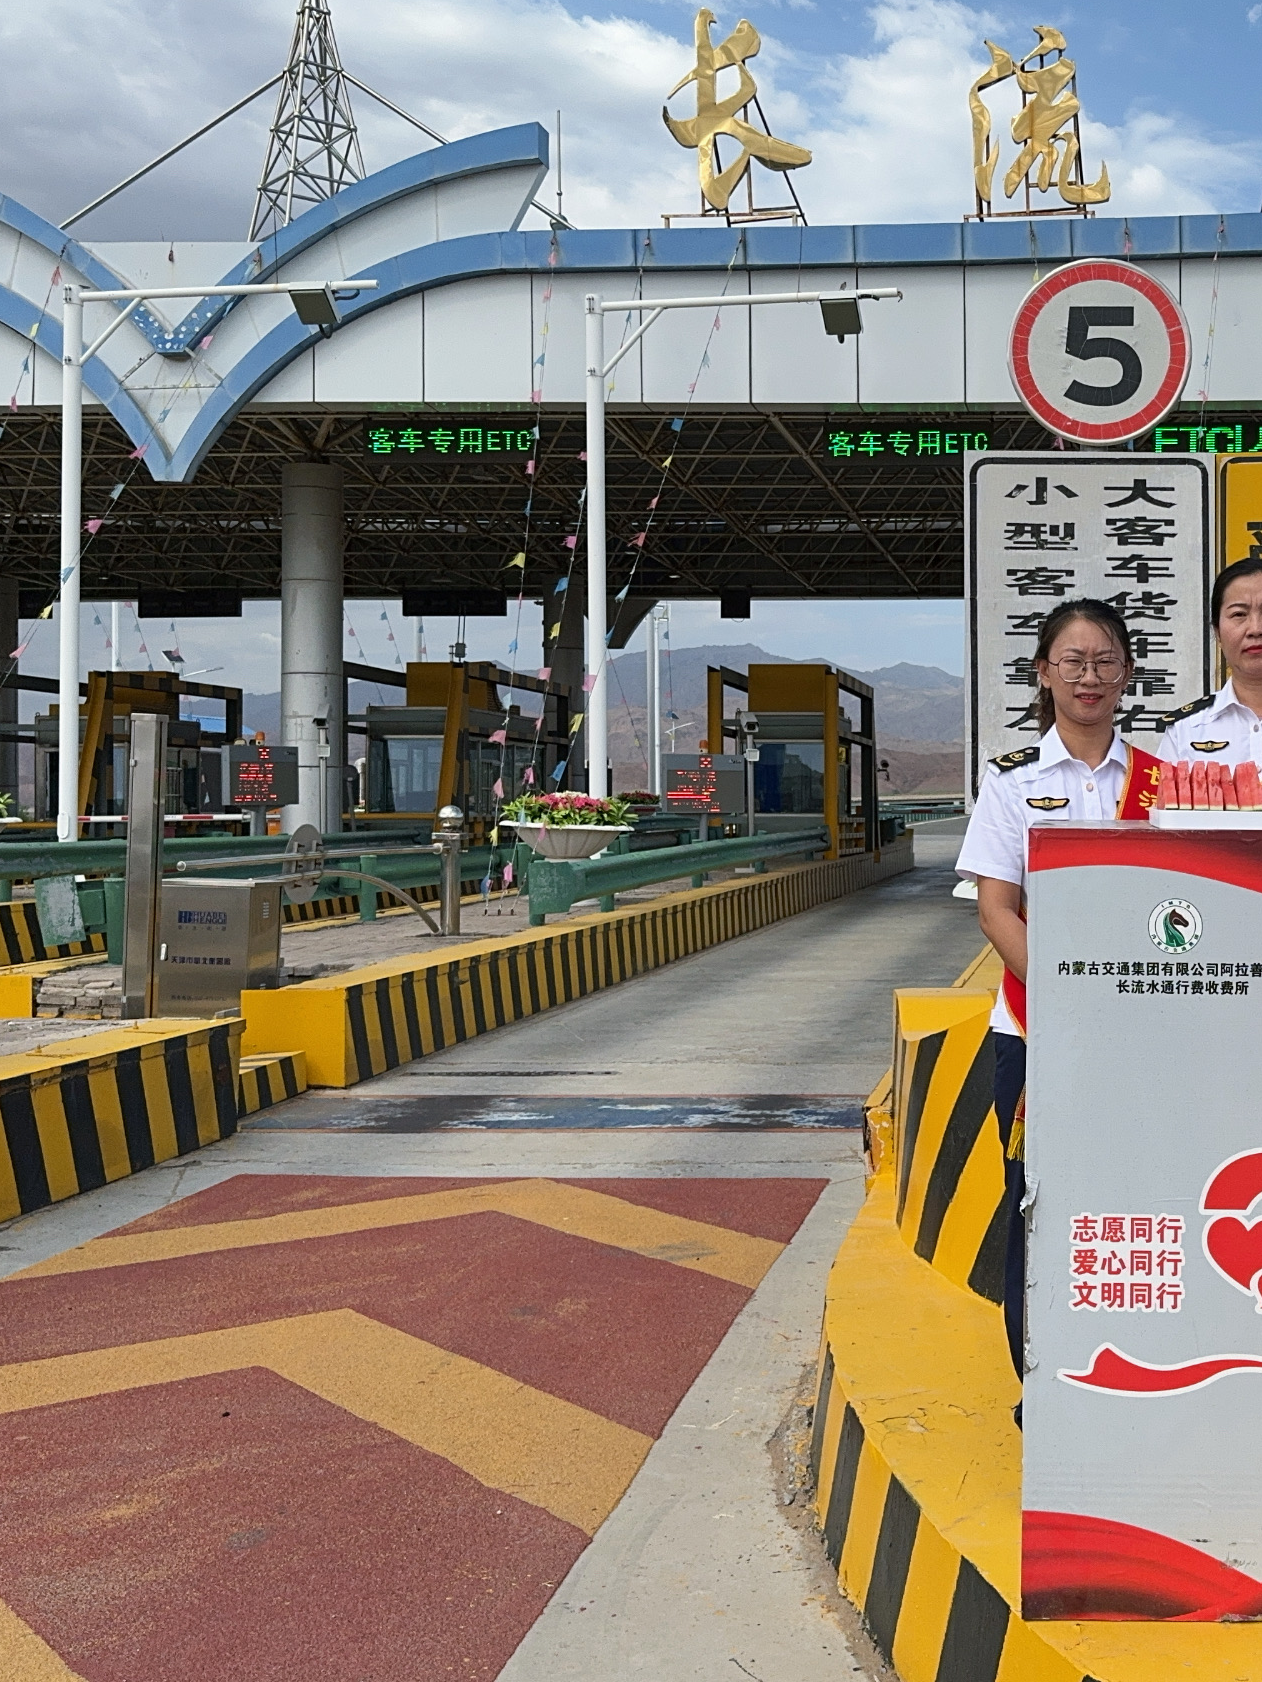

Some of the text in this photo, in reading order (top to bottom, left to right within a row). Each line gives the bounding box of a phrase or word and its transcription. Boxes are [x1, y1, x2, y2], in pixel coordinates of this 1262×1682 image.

[1063, 306, 1142, 406] 5
[368, 428, 532, 453] 客车专用ETC
[828, 430, 988, 456] 客车专用ETC
[1116, 980, 1249, 995] 长流水通行费收费所
[1073, 1216, 1182, 1243] 志愿同行
[1073, 1249, 1182, 1276] 爱心同行
[1073, 1281, 1182, 1309] 文明同行
